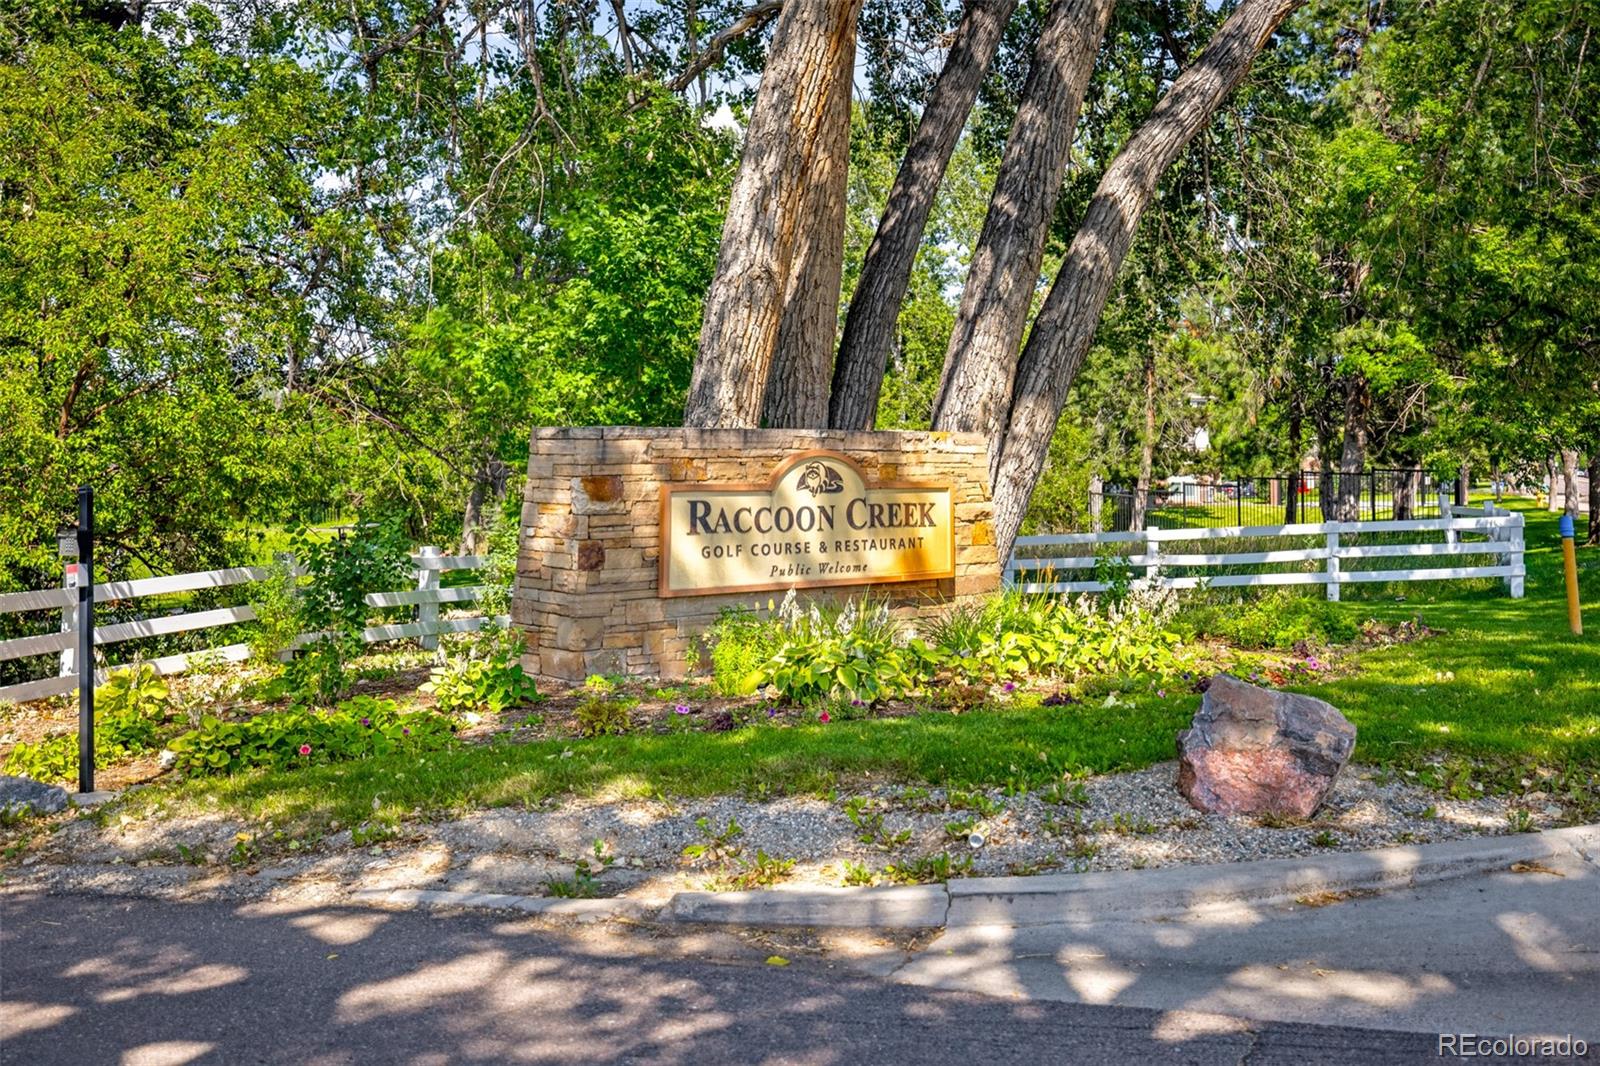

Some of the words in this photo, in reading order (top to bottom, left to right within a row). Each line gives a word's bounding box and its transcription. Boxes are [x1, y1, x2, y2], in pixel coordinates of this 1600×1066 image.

[686, 499, 836, 536] RACCOON
[845, 496, 937, 531] CREEK
[701, 543, 744, 560] GOLF
[750, 540, 811, 557] COURSE
[818, 540, 829, 554] &
[834, 536, 926, 553] RESTAURANT
[769, 563, 812, 578] Public
[818, 561, 869, 575] Welcome
